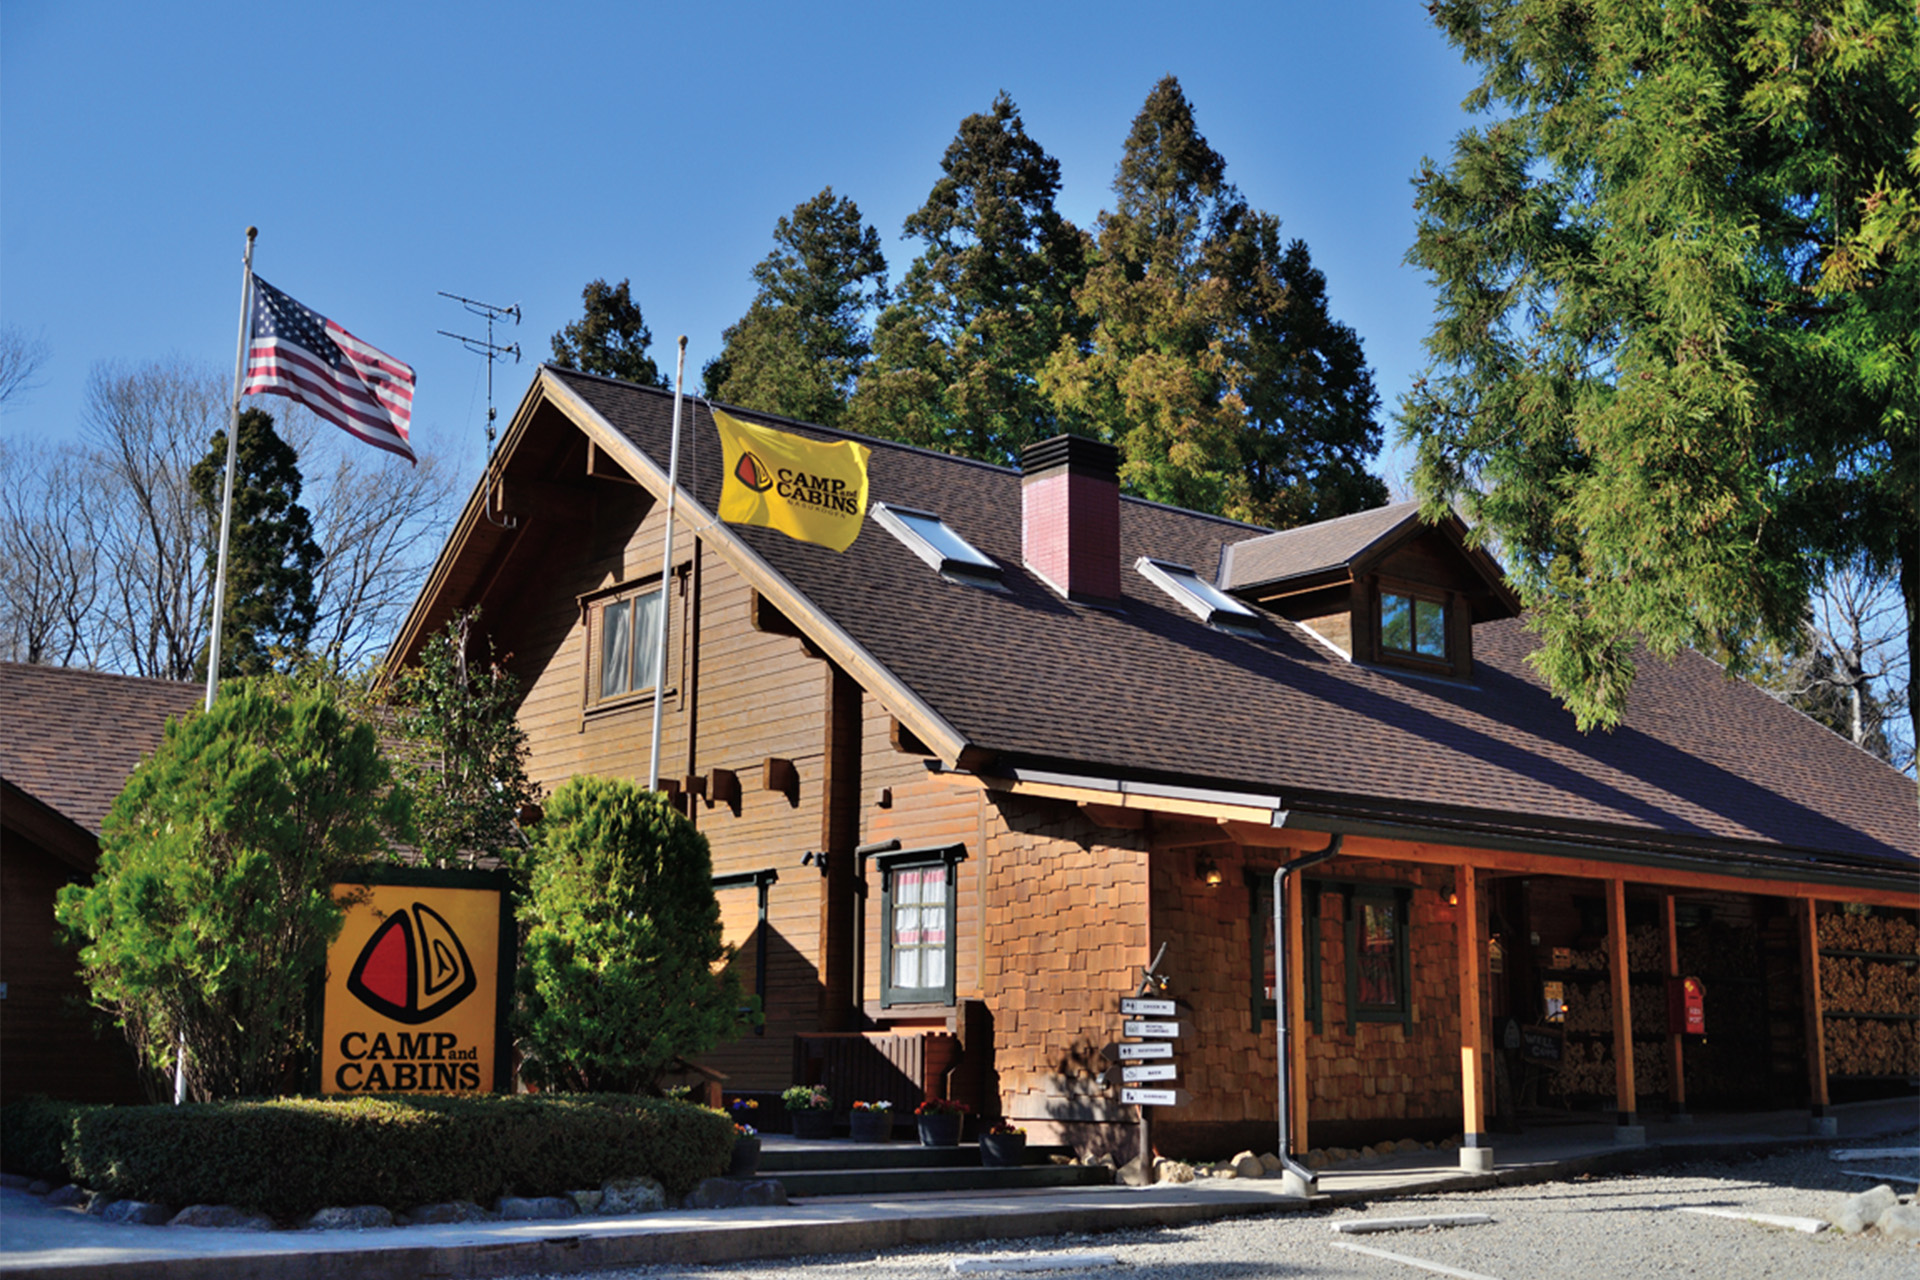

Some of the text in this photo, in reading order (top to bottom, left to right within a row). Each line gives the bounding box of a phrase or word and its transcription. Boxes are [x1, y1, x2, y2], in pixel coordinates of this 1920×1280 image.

[777, 468, 858, 498] CAMP and
[776, 482, 858, 516] CABINS
[340, 1032, 478, 1061] CAMP and
[335, 1062, 481, 1091] CABINS
